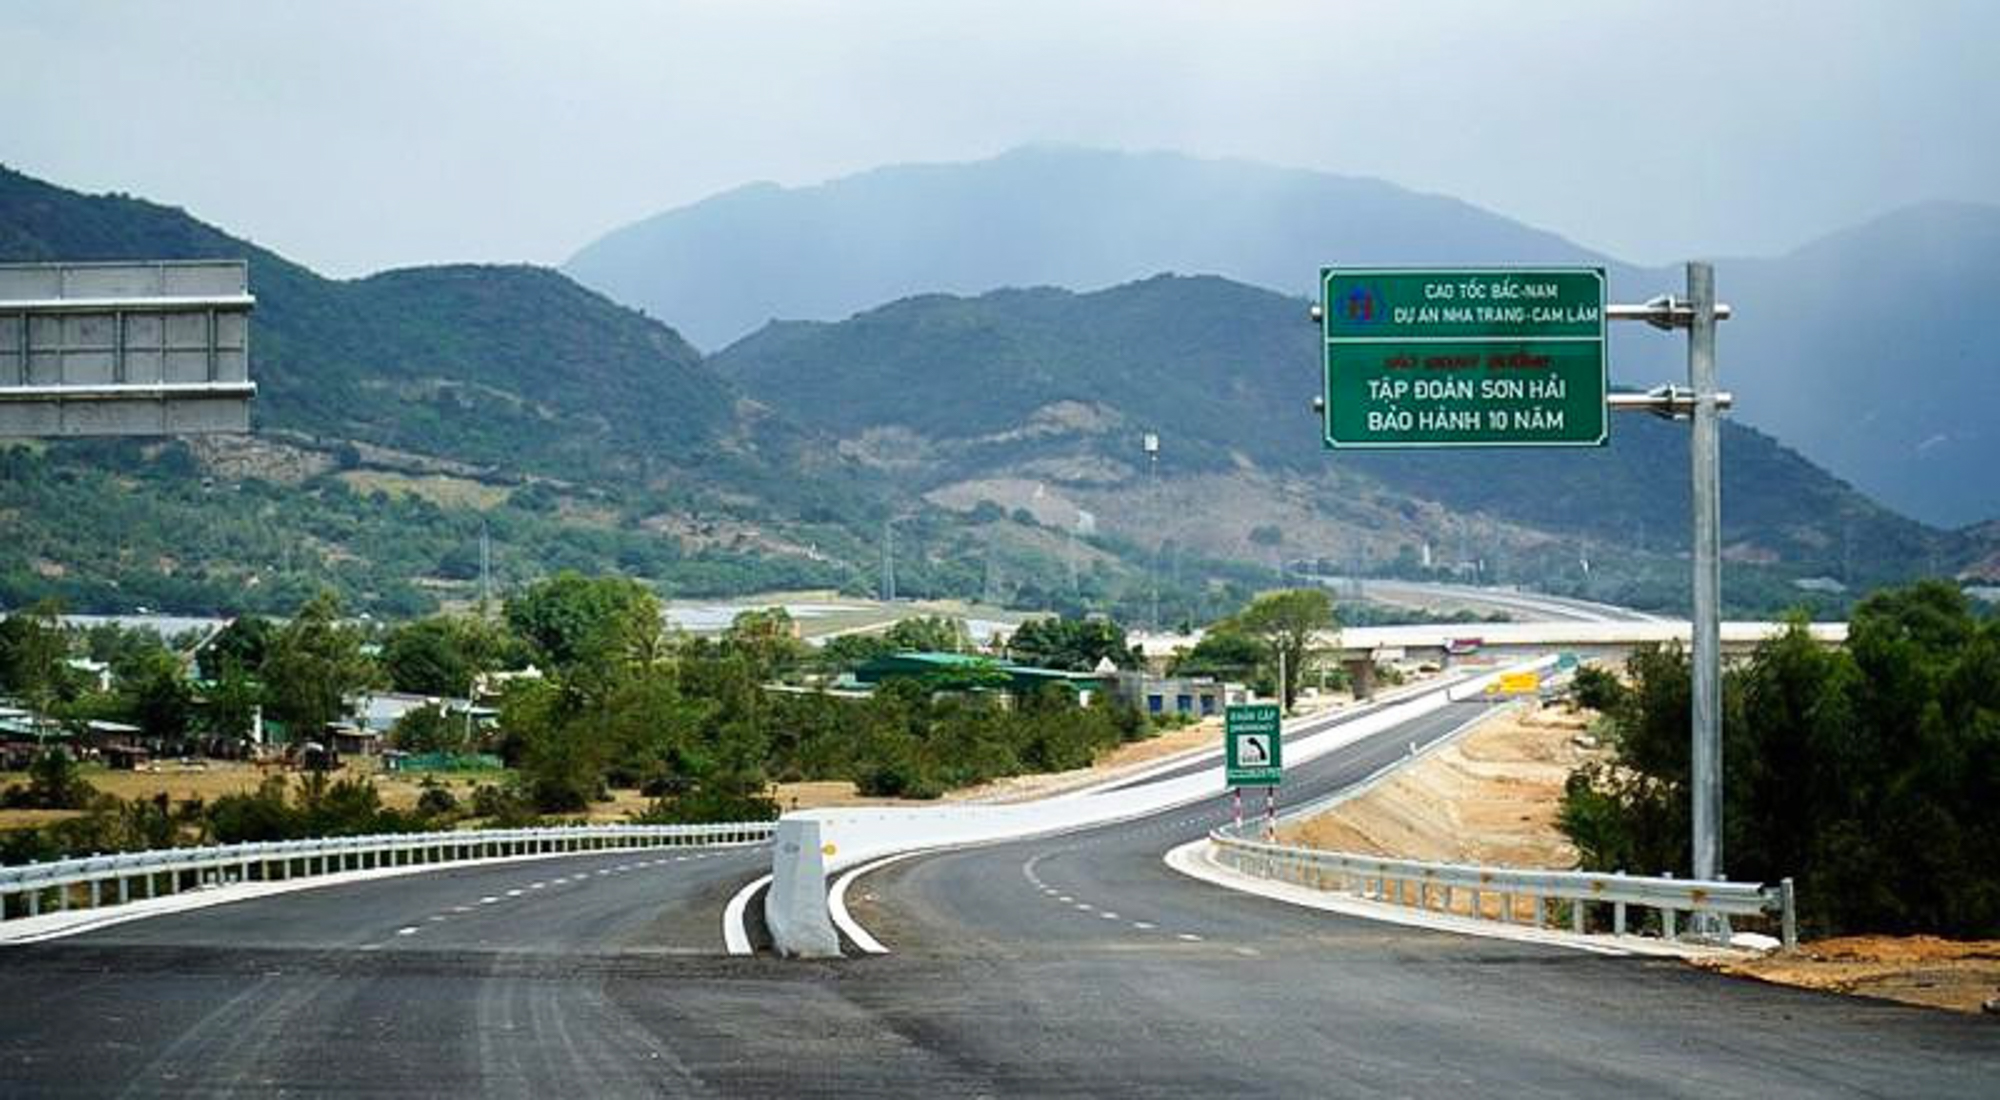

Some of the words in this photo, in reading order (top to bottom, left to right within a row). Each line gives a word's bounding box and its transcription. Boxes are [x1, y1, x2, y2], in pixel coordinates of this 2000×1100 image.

[1424, 283, 1454, 299] CAO
[1459, 277, 1486, 299] TỐC
[1443, 307, 1473, 322] NHA
[1367, 376, 1409, 404] TẬP
[1413, 375, 1474, 399] ĐOÀN
[1481, 379, 1524, 399] SƠN
[1529, 373, 1566, 399] HẢI
[1367, 405, 1413, 431] BẢO
[1419, 405, 1481, 430] HÀNH
[1489, 411, 1508, 430] 10
[1514, 406, 1564, 430] NĂM
